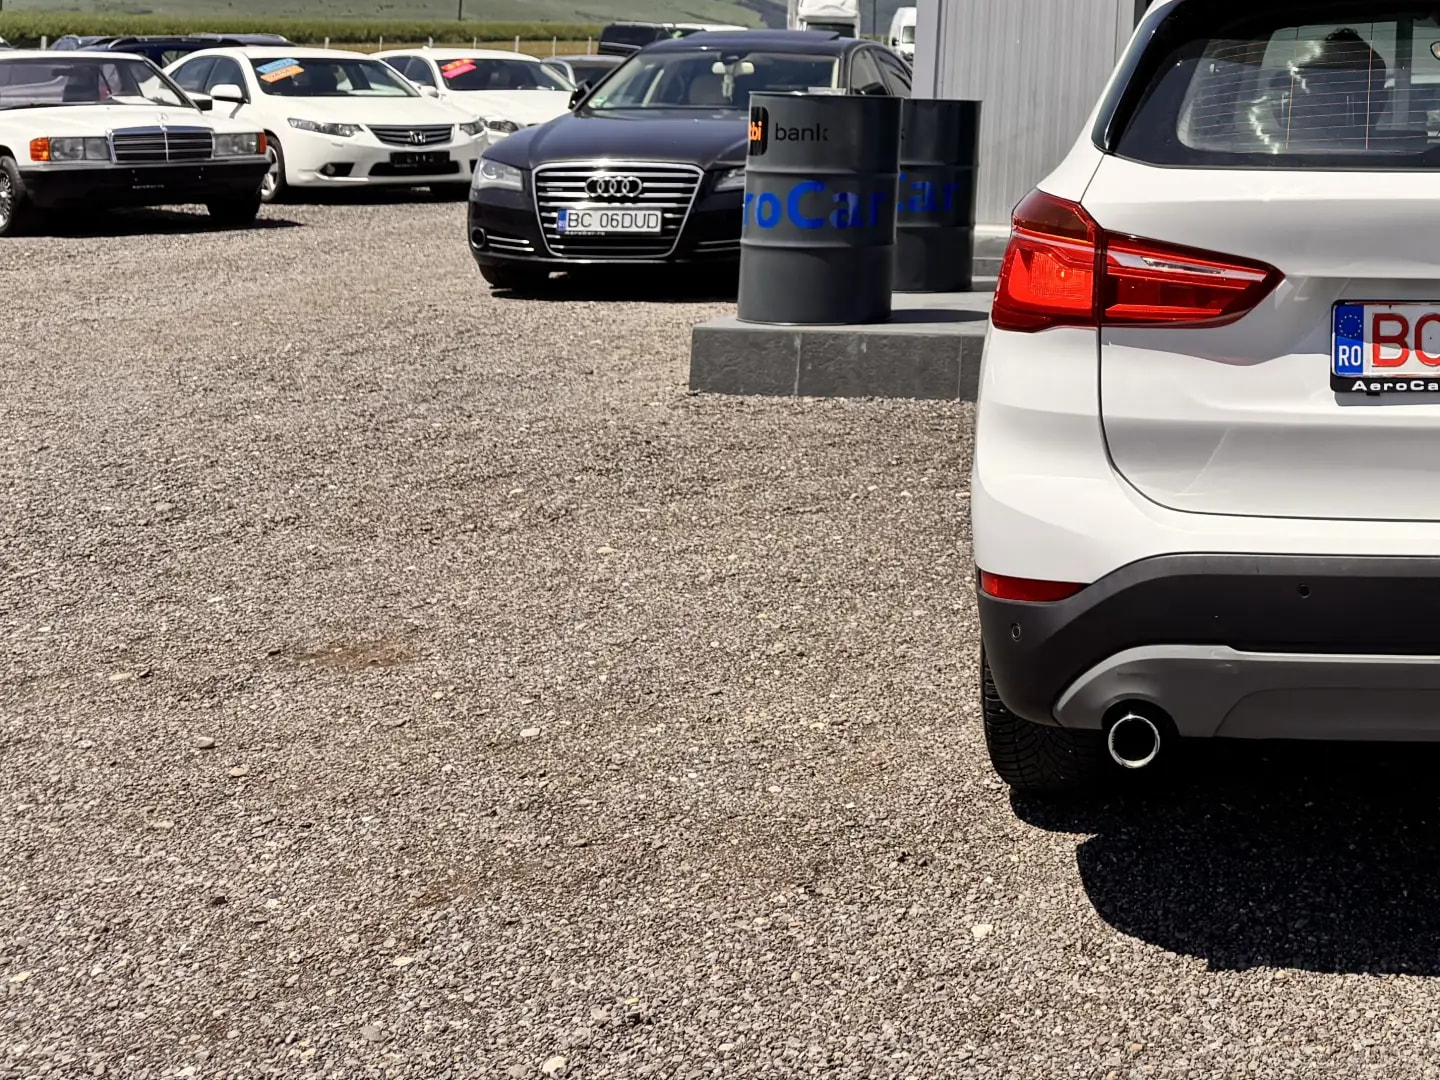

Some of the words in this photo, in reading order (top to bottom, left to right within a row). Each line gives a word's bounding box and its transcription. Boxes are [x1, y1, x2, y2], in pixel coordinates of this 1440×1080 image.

[775, 122, 828, 141] bank
[568, 212, 592, 228] BC
[600, 212, 659, 229] 06DUD
[1338, 345, 1362, 366] RO
